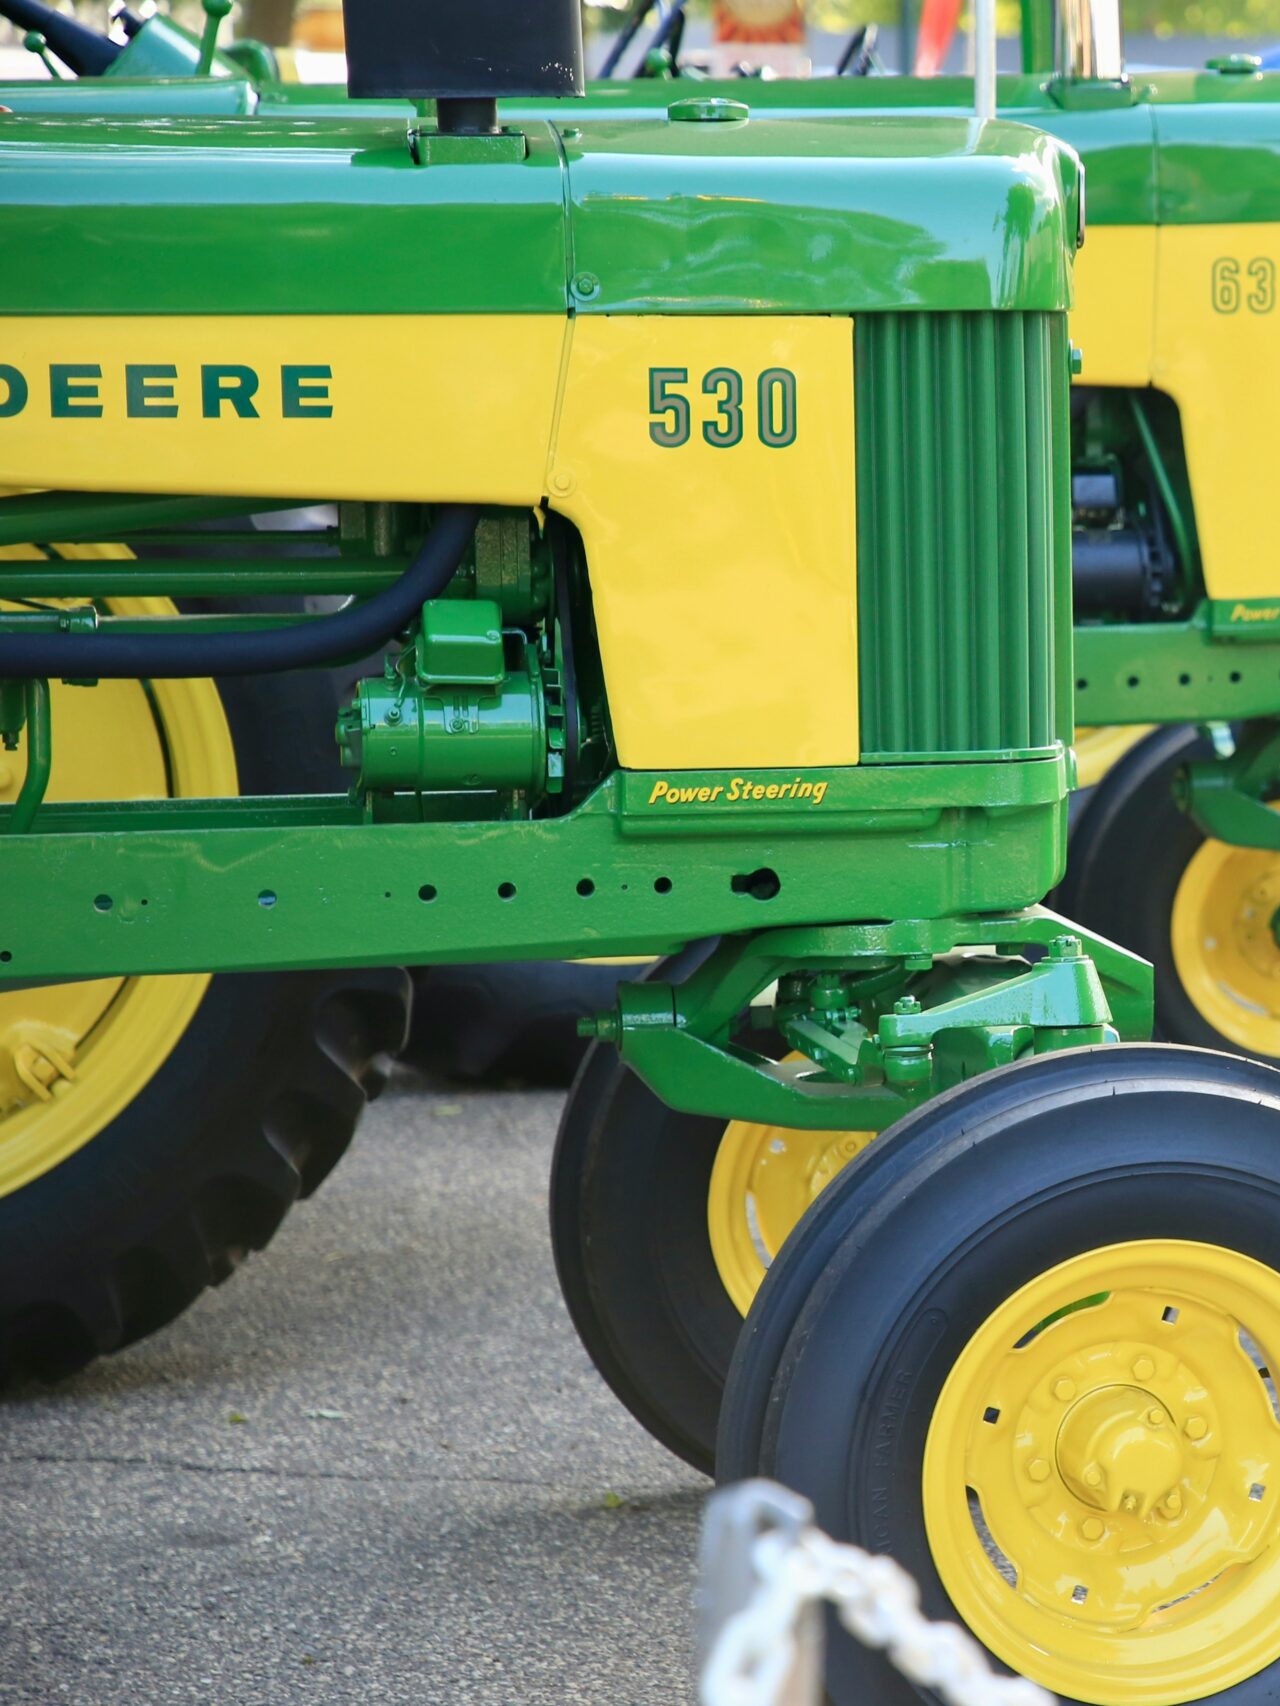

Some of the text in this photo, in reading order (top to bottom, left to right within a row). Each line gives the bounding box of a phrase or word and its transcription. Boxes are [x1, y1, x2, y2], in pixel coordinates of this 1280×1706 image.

[648, 367, 797, 449] 530
[1230, 603, 1280, 622] Power
[648, 777, 828, 806] Power Steering
